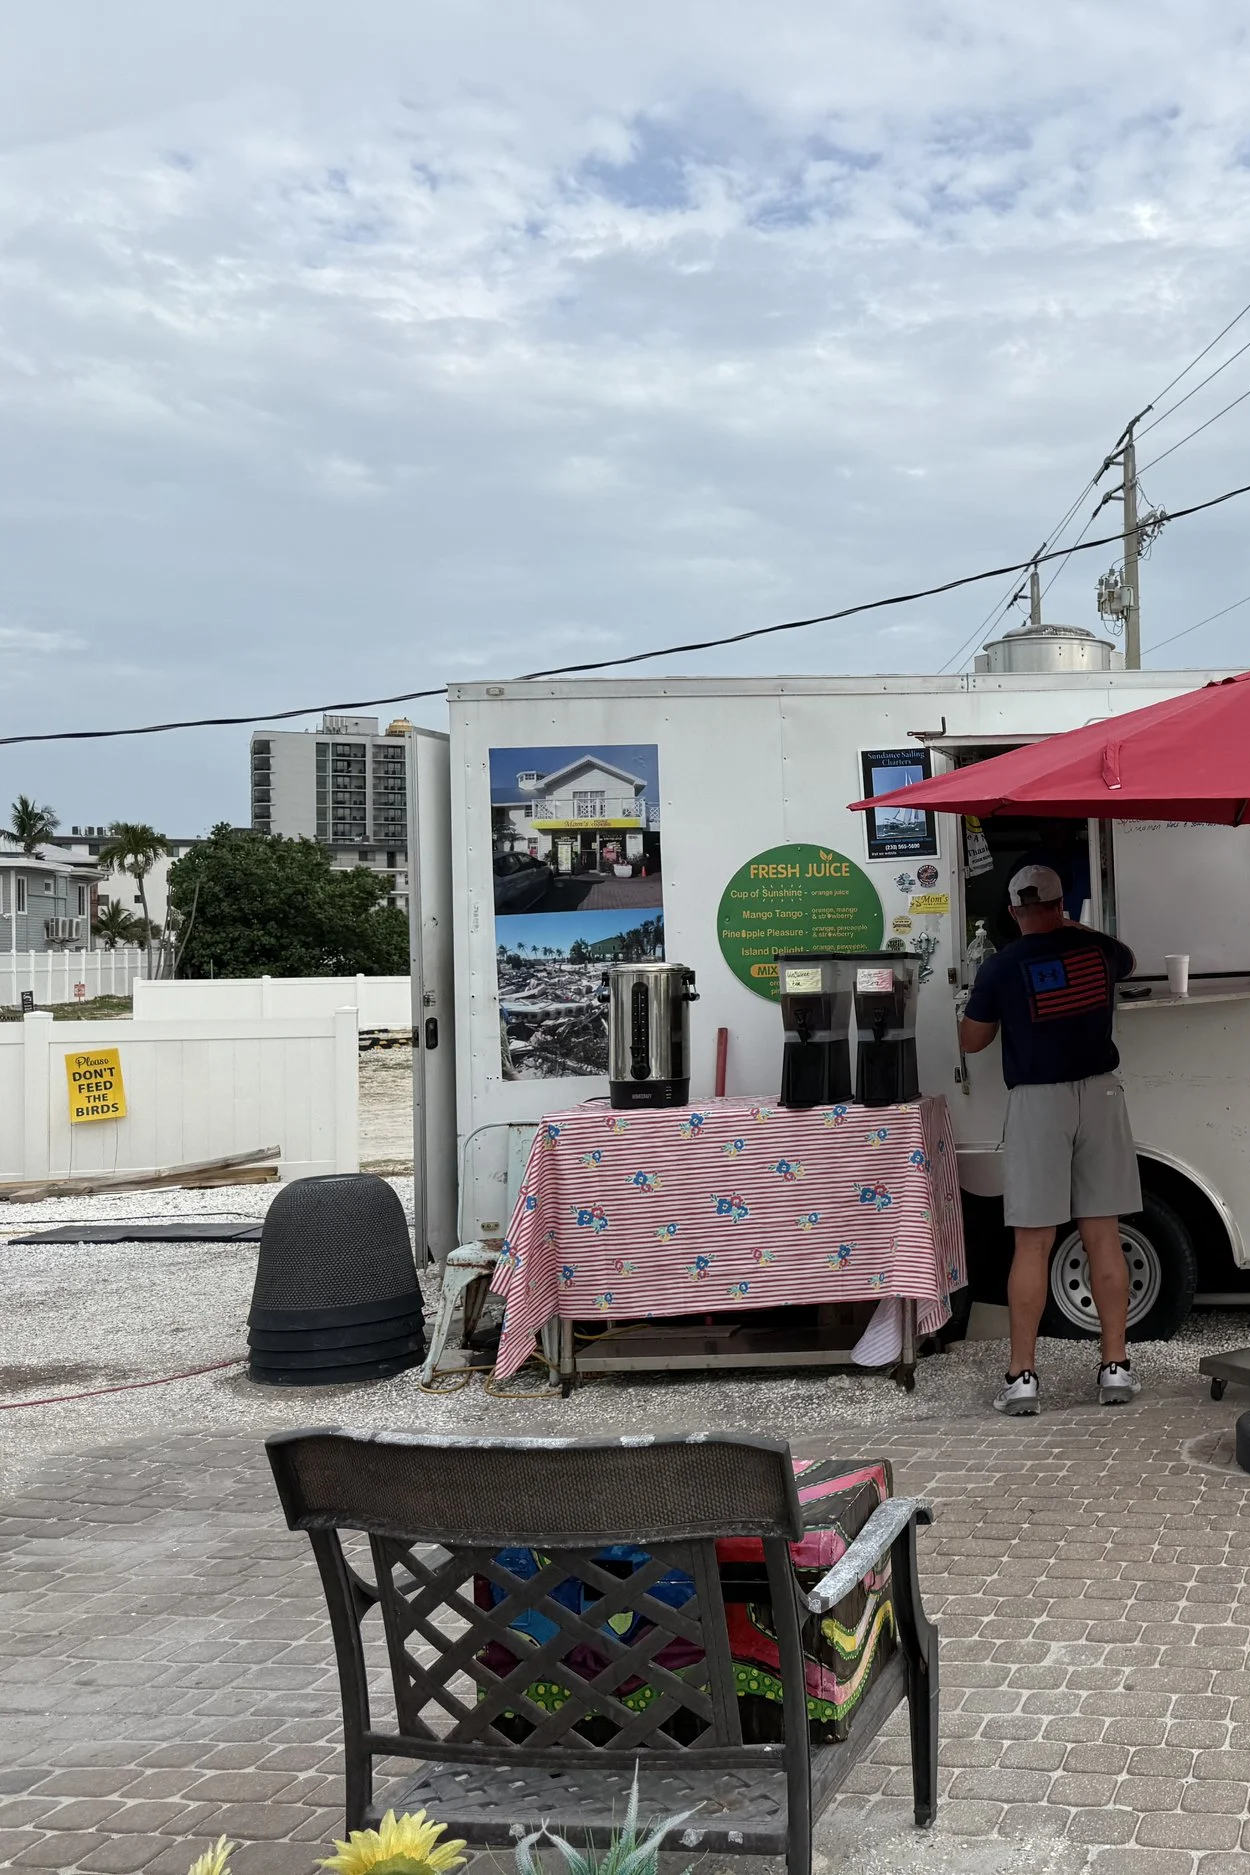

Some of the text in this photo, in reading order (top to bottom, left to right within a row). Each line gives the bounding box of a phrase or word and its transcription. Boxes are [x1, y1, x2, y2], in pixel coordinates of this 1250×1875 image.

[750, 862, 850, 879] FRESH JUICE
[731, 890, 748, 899] Cup
[750, 889, 759, 898] of
[762, 889, 802, 897] Sunshine
[922, 894, 948, 903] Mom's
[743, 910, 772, 920] Mango
[775, 910, 803, 920] Tango
[767, 929, 804, 937] Pleasure
[742, 947, 769, 956] Island
[772, 946, 803, 954] Delight
[757, 966, 777, 976] MIX
[75, 1056, 109, 1068] Please
[72, 1067, 115, 1082] DON'T
[78, 1081, 113, 1094] FEED
[85, 1093, 108, 1103] THE
[76, 1103, 119, 1117] BIRDS
